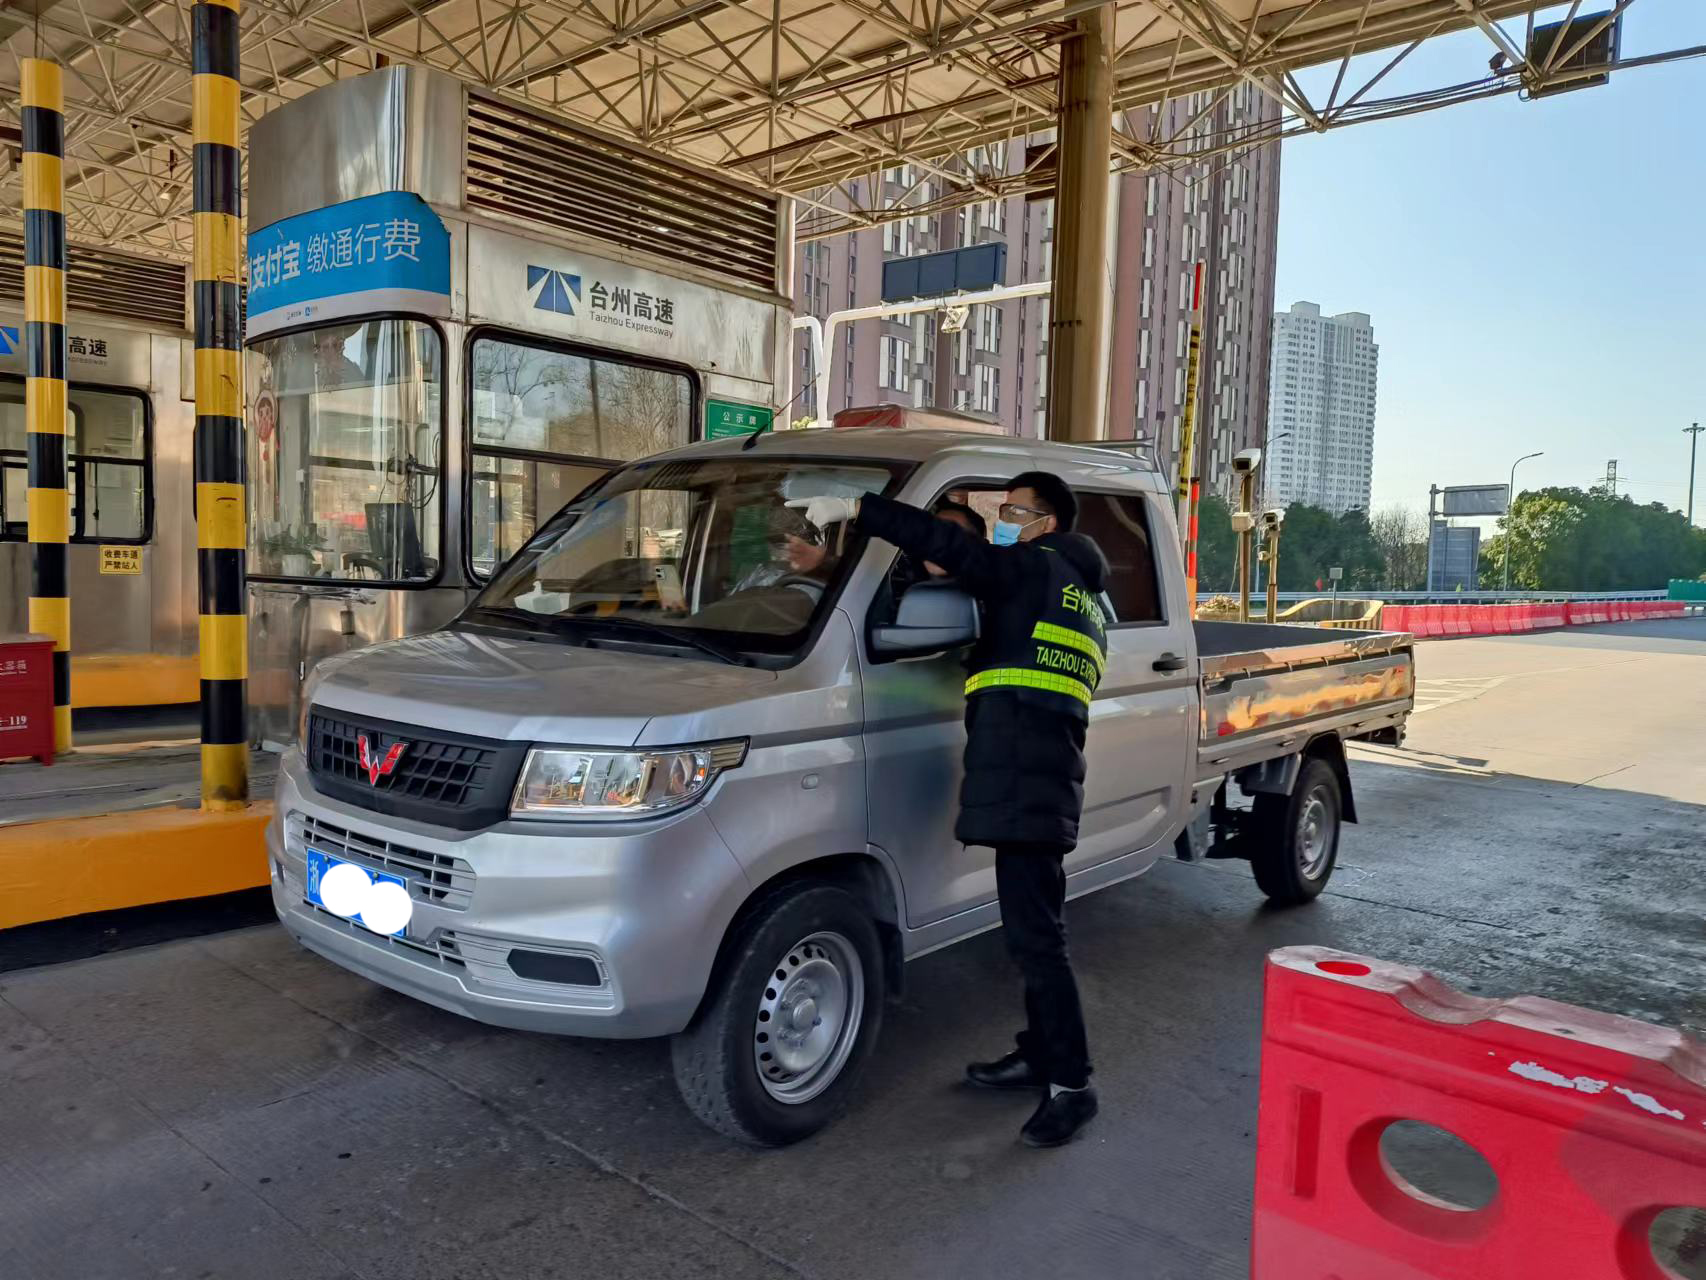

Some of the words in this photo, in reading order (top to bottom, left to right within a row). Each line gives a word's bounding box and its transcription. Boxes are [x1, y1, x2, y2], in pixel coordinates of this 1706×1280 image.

[247, 239, 301, 293] 支付宝
[306, 217, 421, 273] 缴通行费
[589, 281, 674, 325] 台州高速
[590, 311, 624, 327] Taizhou
[625, 318, 674, 339] Expressway
[68, 336, 107, 357] 高速
[1036, 646, 1080, 673] TAIZHOU
